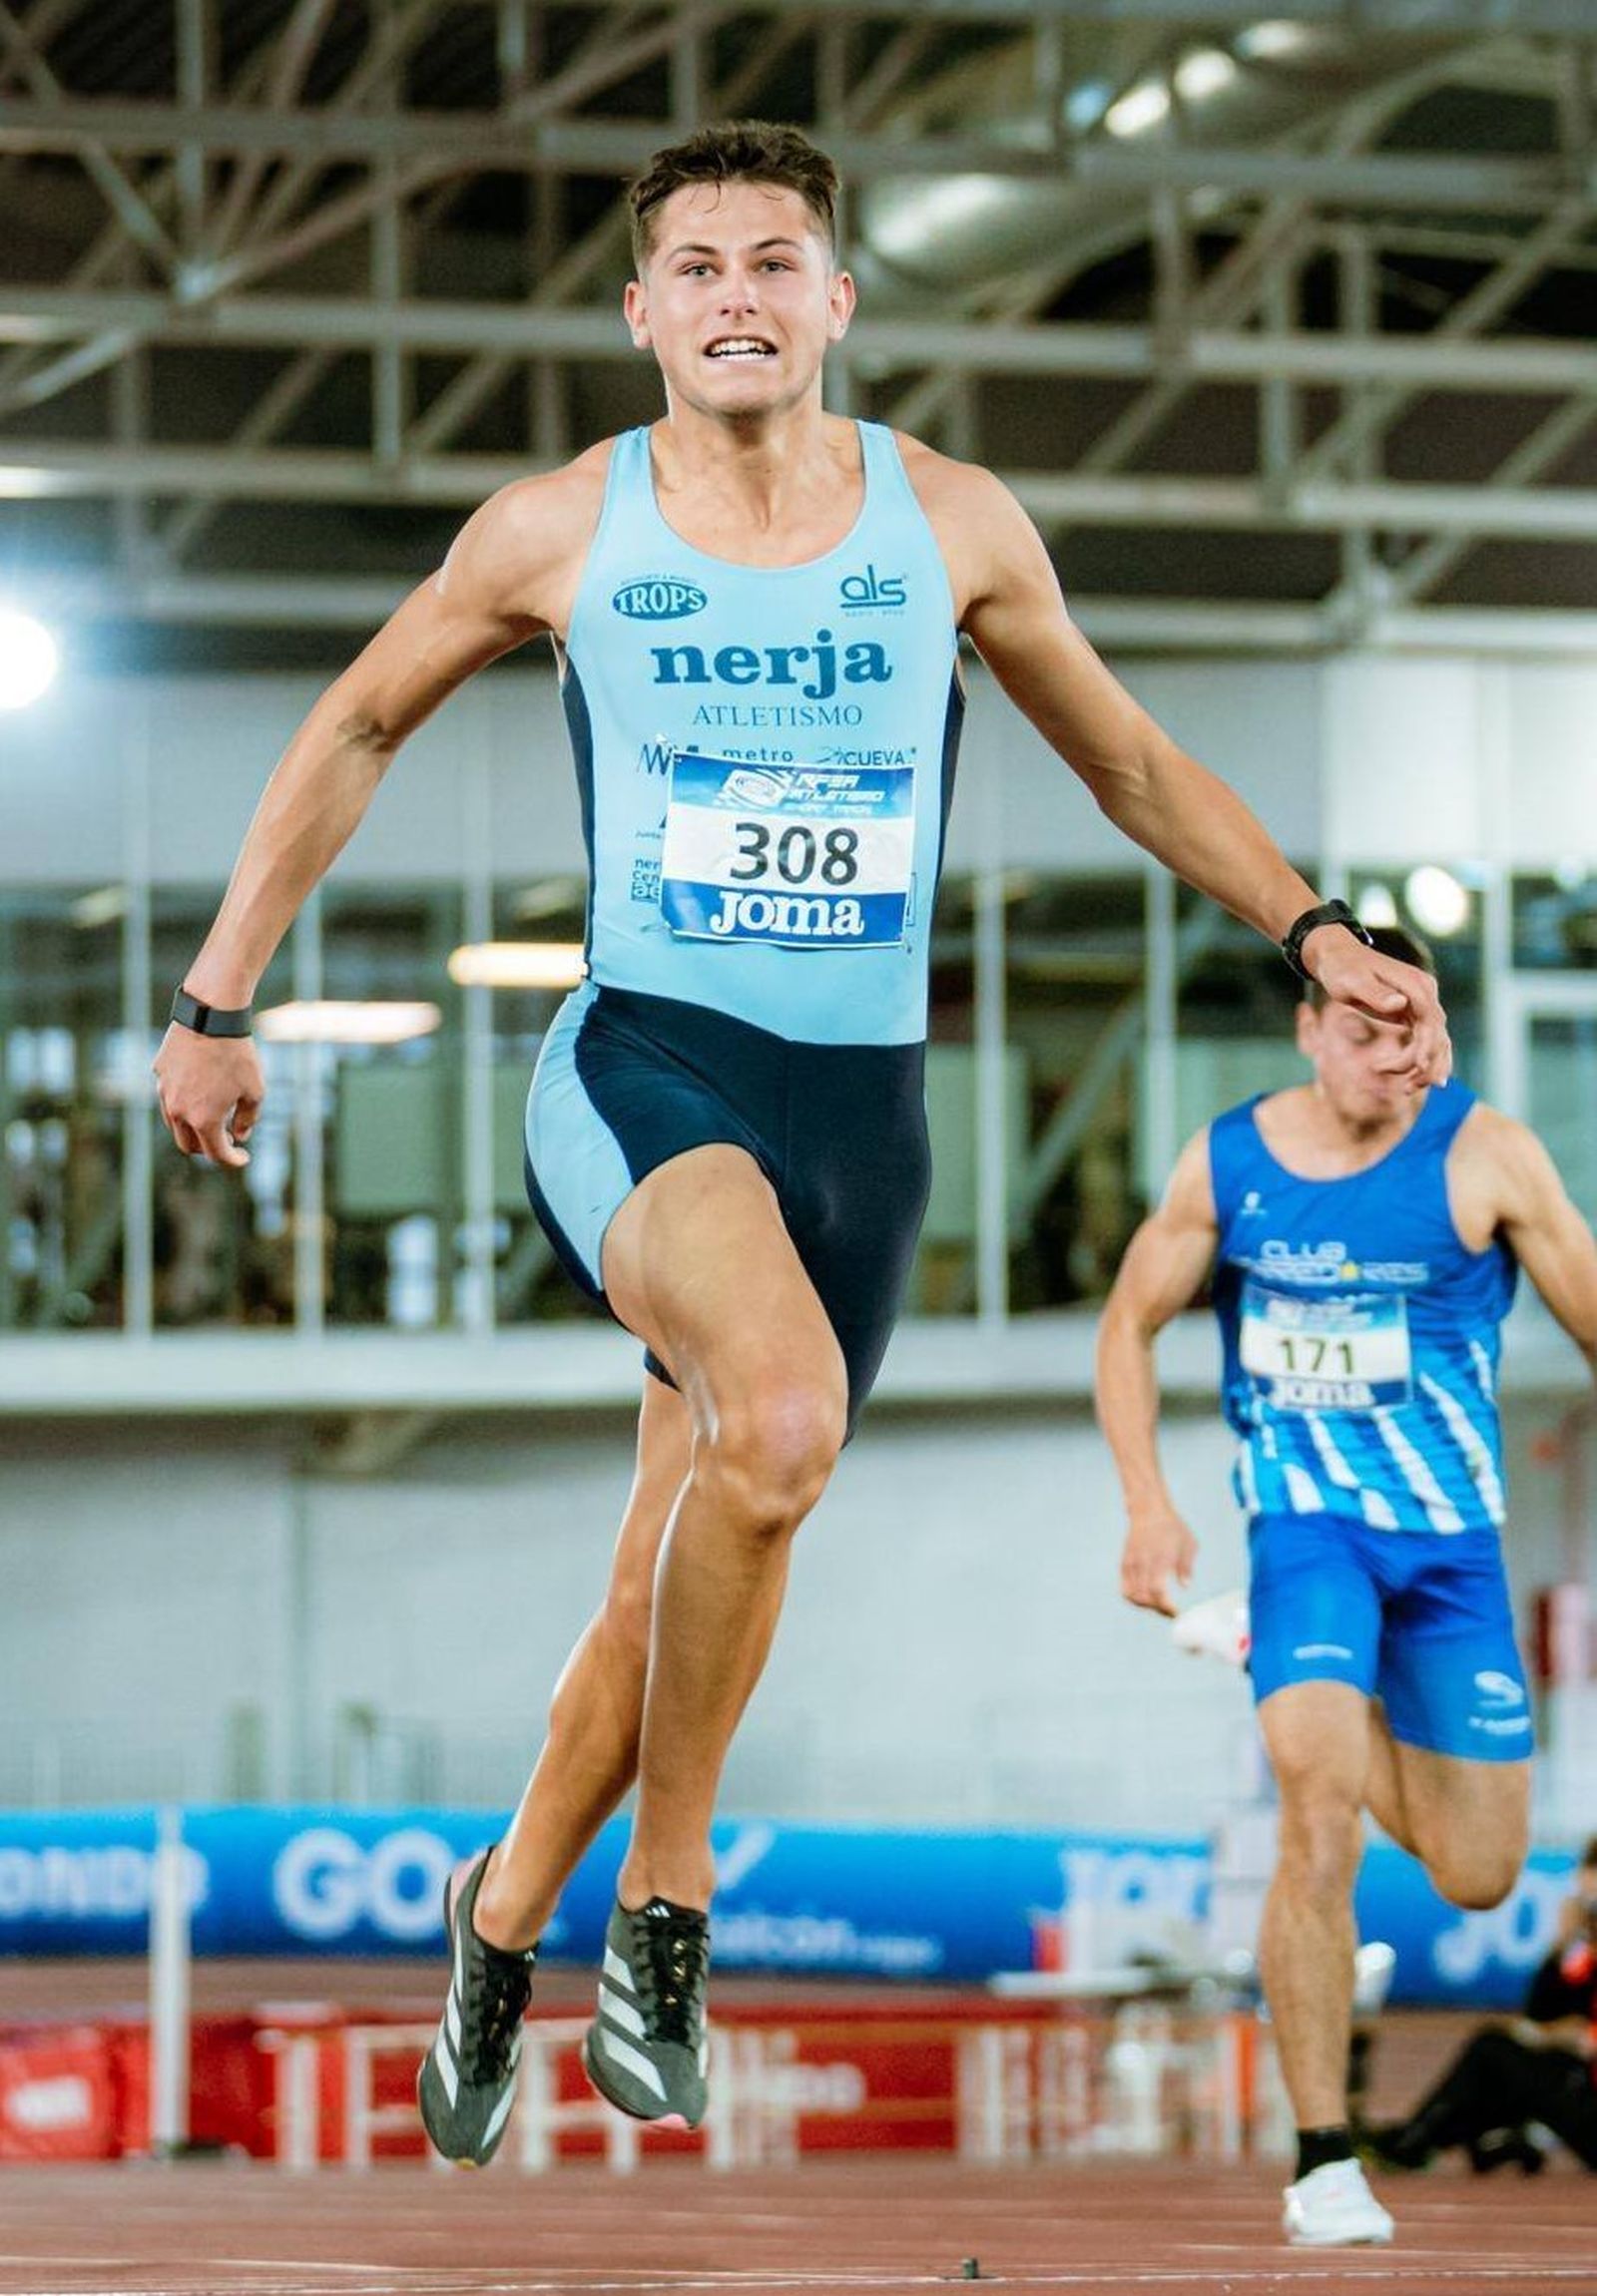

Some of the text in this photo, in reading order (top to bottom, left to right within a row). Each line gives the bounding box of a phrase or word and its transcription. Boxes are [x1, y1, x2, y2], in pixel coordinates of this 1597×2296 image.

[615, 583, 705, 615] TROPS
[840, 564, 906, 609] als
[651, 629, 892, 699] nerja
[693, 703, 863, 727] ATLETISMO
[723, 747, 794, 762] metro
[844, 749, 905, 766] CUEVA
[729, 821, 859, 887] 308
[1281, 1337, 1354, 1374] 171
